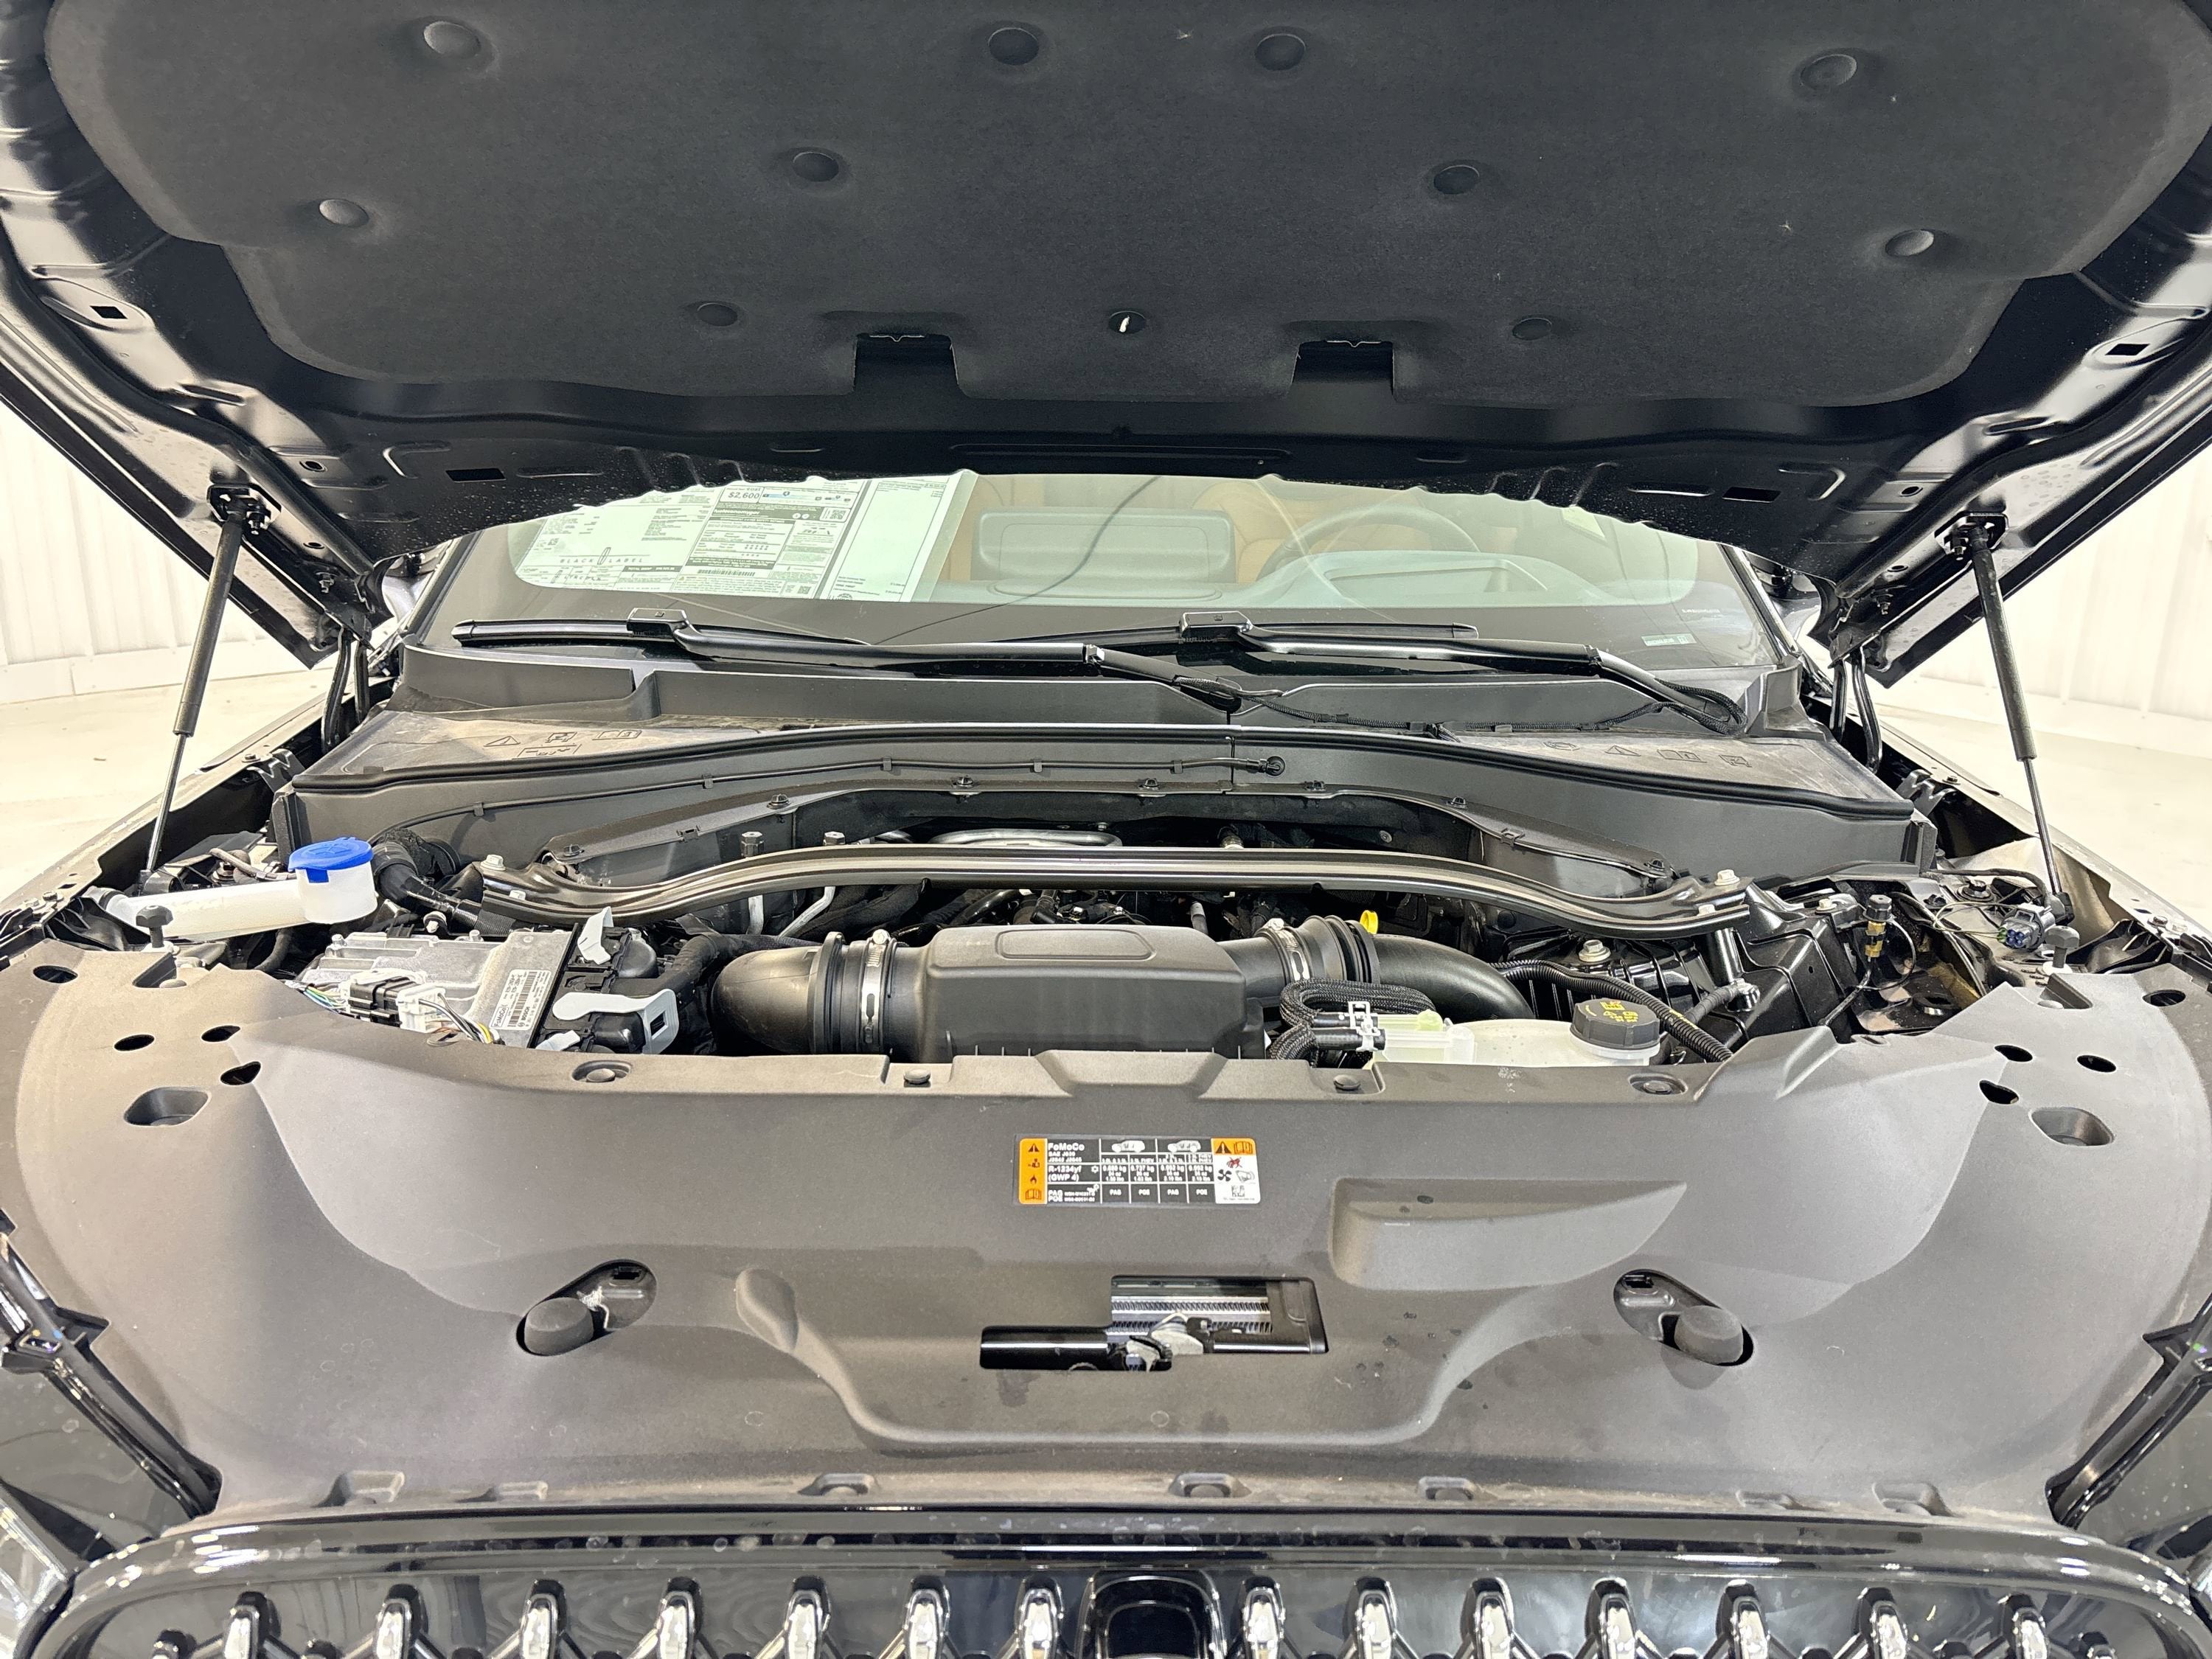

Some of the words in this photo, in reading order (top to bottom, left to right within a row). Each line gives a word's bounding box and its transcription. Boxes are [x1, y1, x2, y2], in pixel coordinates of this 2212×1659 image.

[521, 1006, 530, 1020] BOSCH
[1048, 1143, 1085, 1151] FoMoCo
[1048, 1165, 1082, 1174] R-1234yf
[1048, 1174, 1071, 1182] (GWP
[1071, 1174, 1079, 1182] 4)
